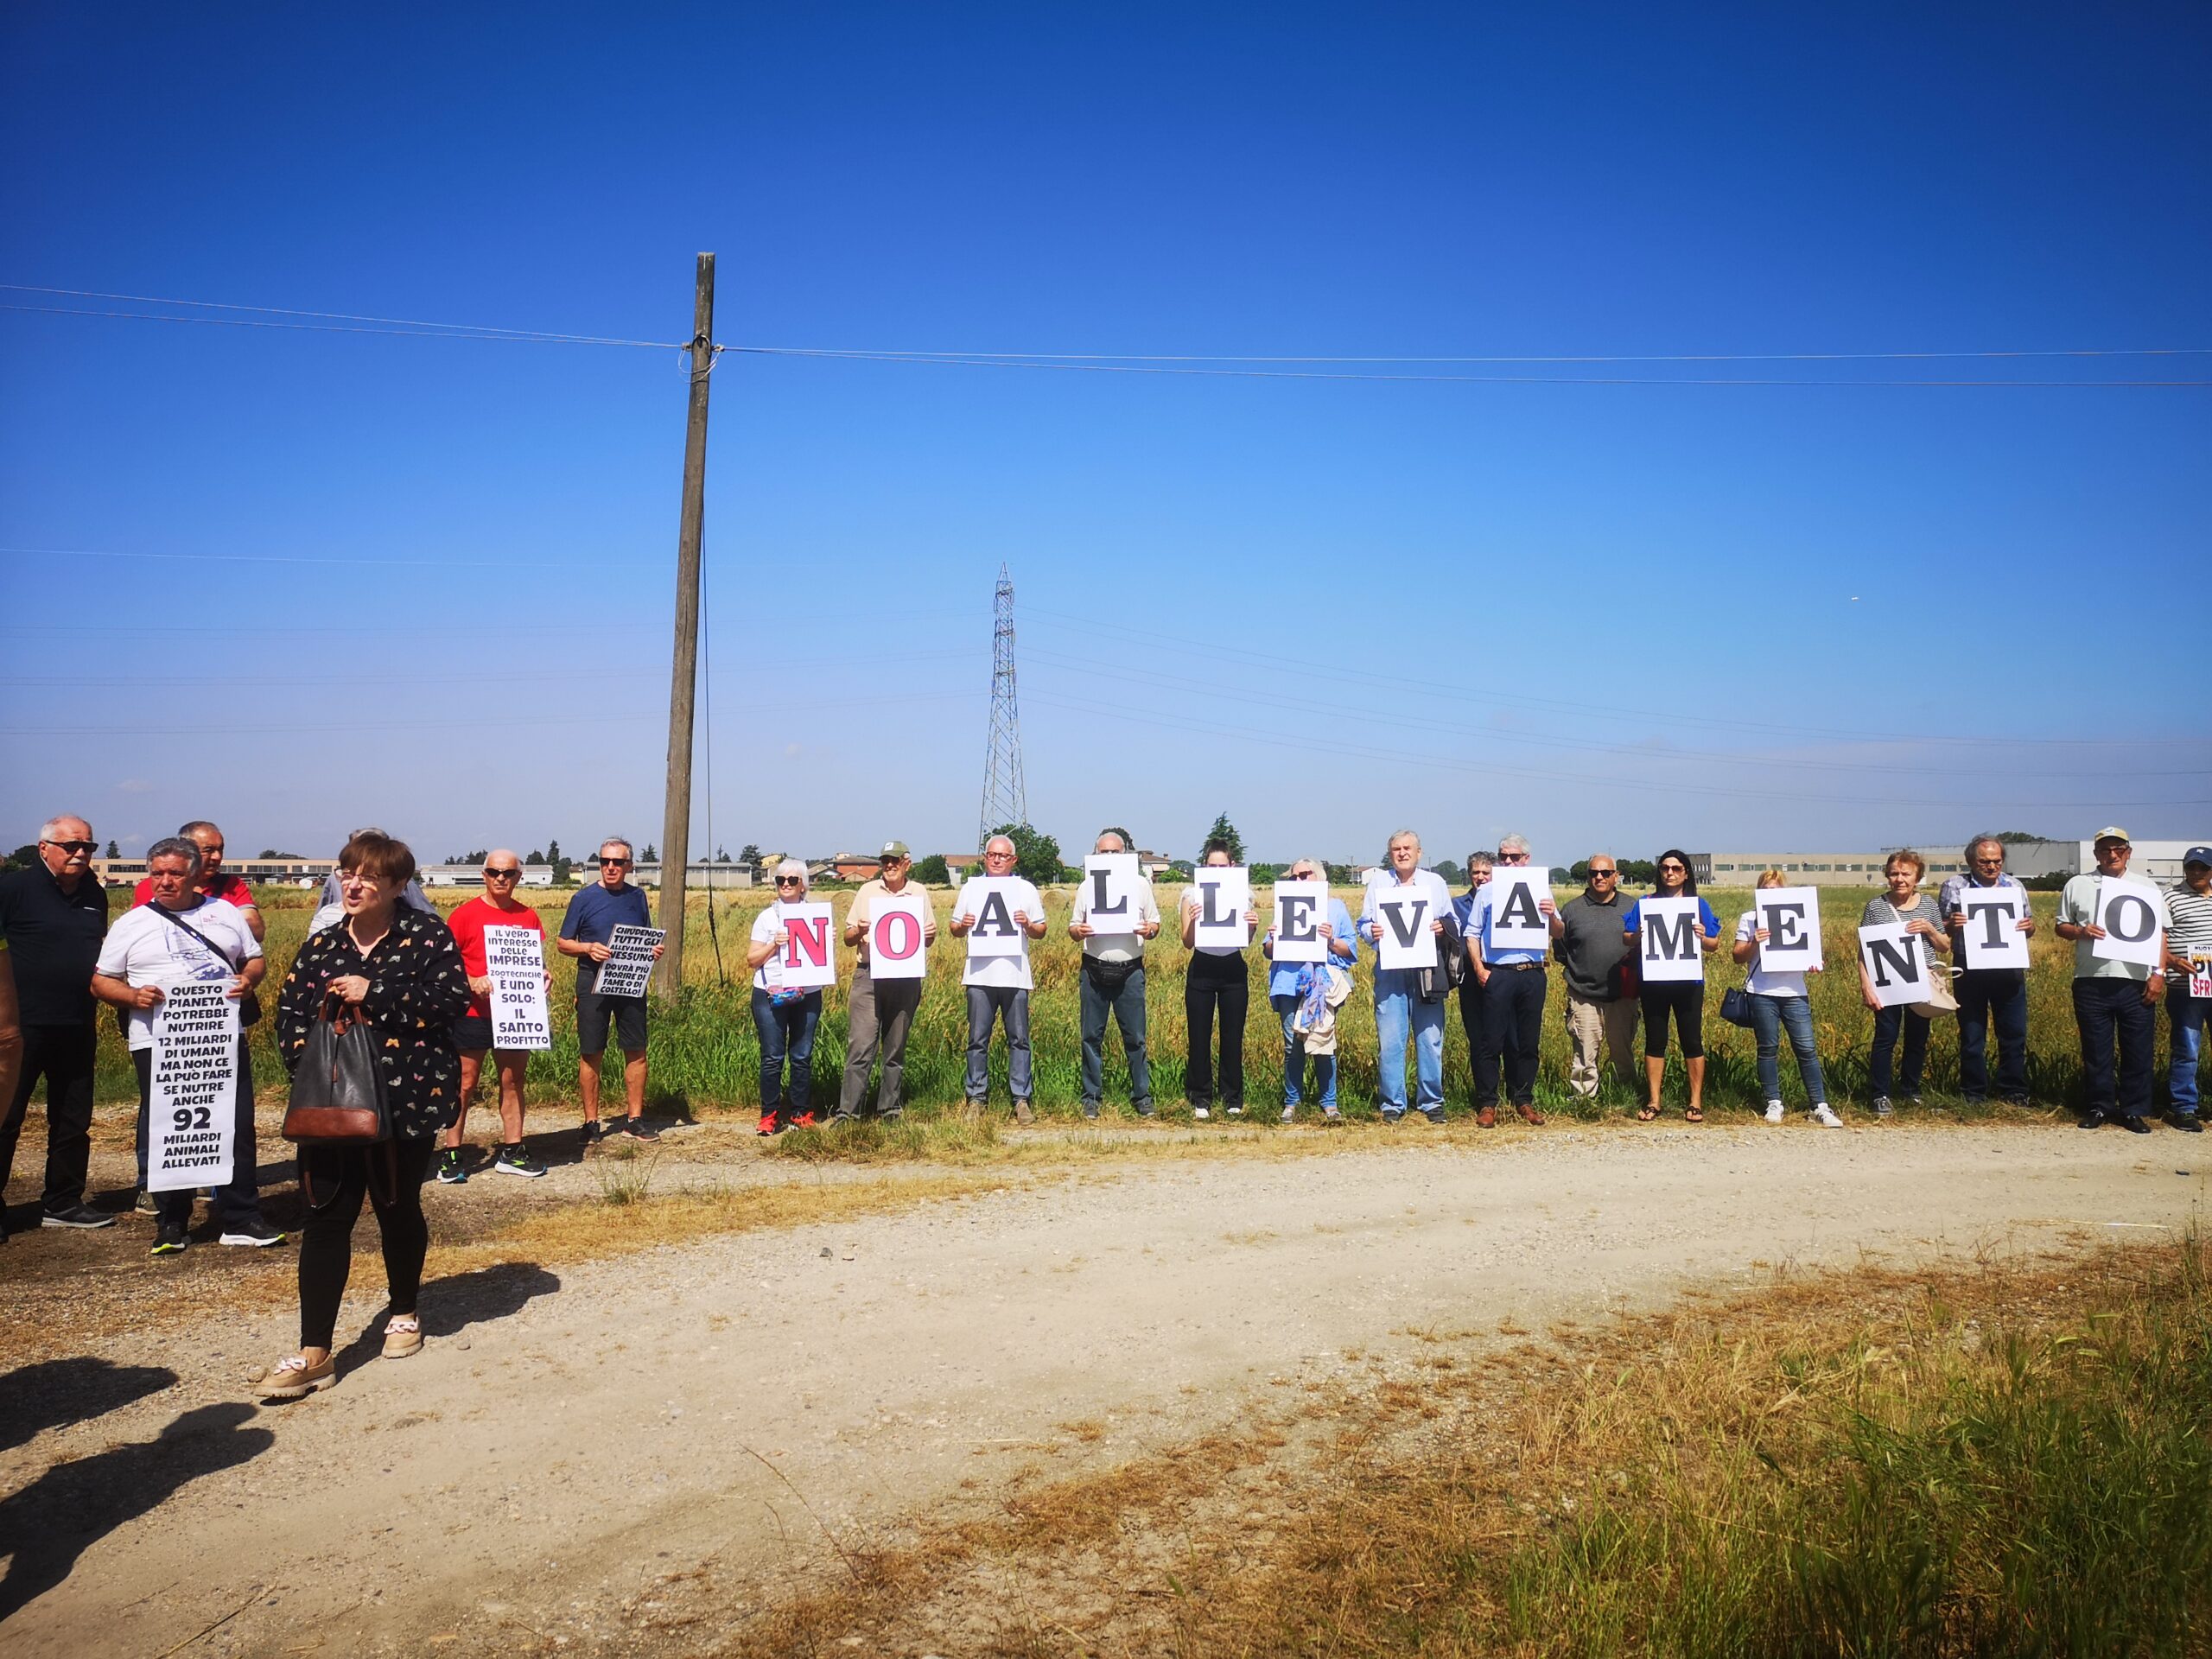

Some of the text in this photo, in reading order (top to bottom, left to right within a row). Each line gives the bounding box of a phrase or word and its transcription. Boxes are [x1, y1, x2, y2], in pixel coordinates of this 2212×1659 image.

[1090, 869, 1128, 914] L
[1199, 882, 1236, 927] L
[1496, 882, 1546, 930] A
[971, 892, 1019, 937] A
[1278, 896, 1317, 942] E
[2104, 895, 2157, 943] O
[1379, 900, 1428, 948] V
[1761, 903, 1808, 951] E
[1967, 902, 2016, 949] T
[616, 927, 663, 938] CHIUDENDO
[874, 911, 921, 960] O
[1643, 912, 1699, 961] M
[614, 935, 642, 944] TUTTI
[783, 917, 830, 969] N
[610, 944, 653, 953] ALLEVAMENT
[489, 955, 541, 966] IMPRESE
[610, 951, 654, 962] NESSUNO
[1866, 936, 1919, 987] N
[605, 963, 633, 972] DOVRÀ
[604, 971, 636, 980] MORIRE
[500, 976, 506, 989] È
[2193, 978, 2212, 996] SFR
[171, 985, 223, 996] QUESTO
[601, 987, 641, 995] COLTELLO!
[168, 997, 224, 1008] PIANETA
[501, 994, 536, 1004] SOLO:
[163, 1008, 230, 1020] POTREBBE
[515, 1008, 525, 1019] IL
[168, 1020, 225, 1033] NUTRIRE
[499, 1022, 543, 1033] SANTO
[158, 1033, 232, 1046] 12 MILIARDI
[496, 1035, 549, 1045] PROFITTO
[164, 1046, 225, 1058] DI UMANI
[161, 1058, 229, 1071] MA NON CE
[156, 1069, 232, 1083] LA PUÒ FARE
[163, 1082, 225, 1095] SE NUTRE
[172, 1094, 215, 1106] ANCHE
[173, 1107, 211, 1131] 92
[163, 1133, 221, 1145] MILIARDI
[164, 1144, 219, 1156] ANIMALI
[162, 1156, 220, 1169] ALLEVATI
